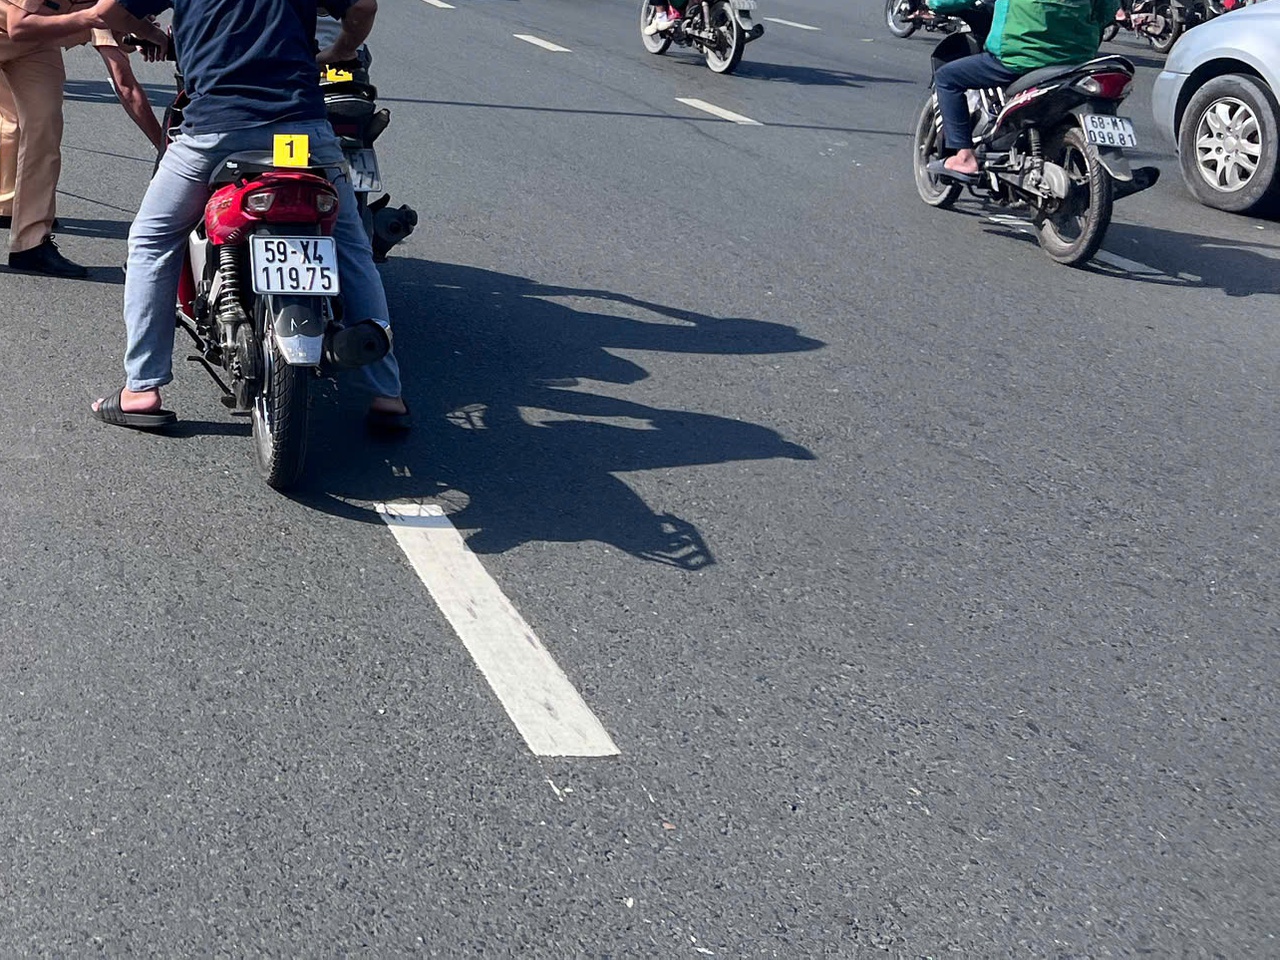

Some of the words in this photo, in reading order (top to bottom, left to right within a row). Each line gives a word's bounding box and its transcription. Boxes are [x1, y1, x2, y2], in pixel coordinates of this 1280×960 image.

[1088, 130, 1135, 147] 098.81
[284, 140, 295, 159] 1
[263, 240, 324, 264] 59-X4
[262, 267, 332, 290] 119.75
